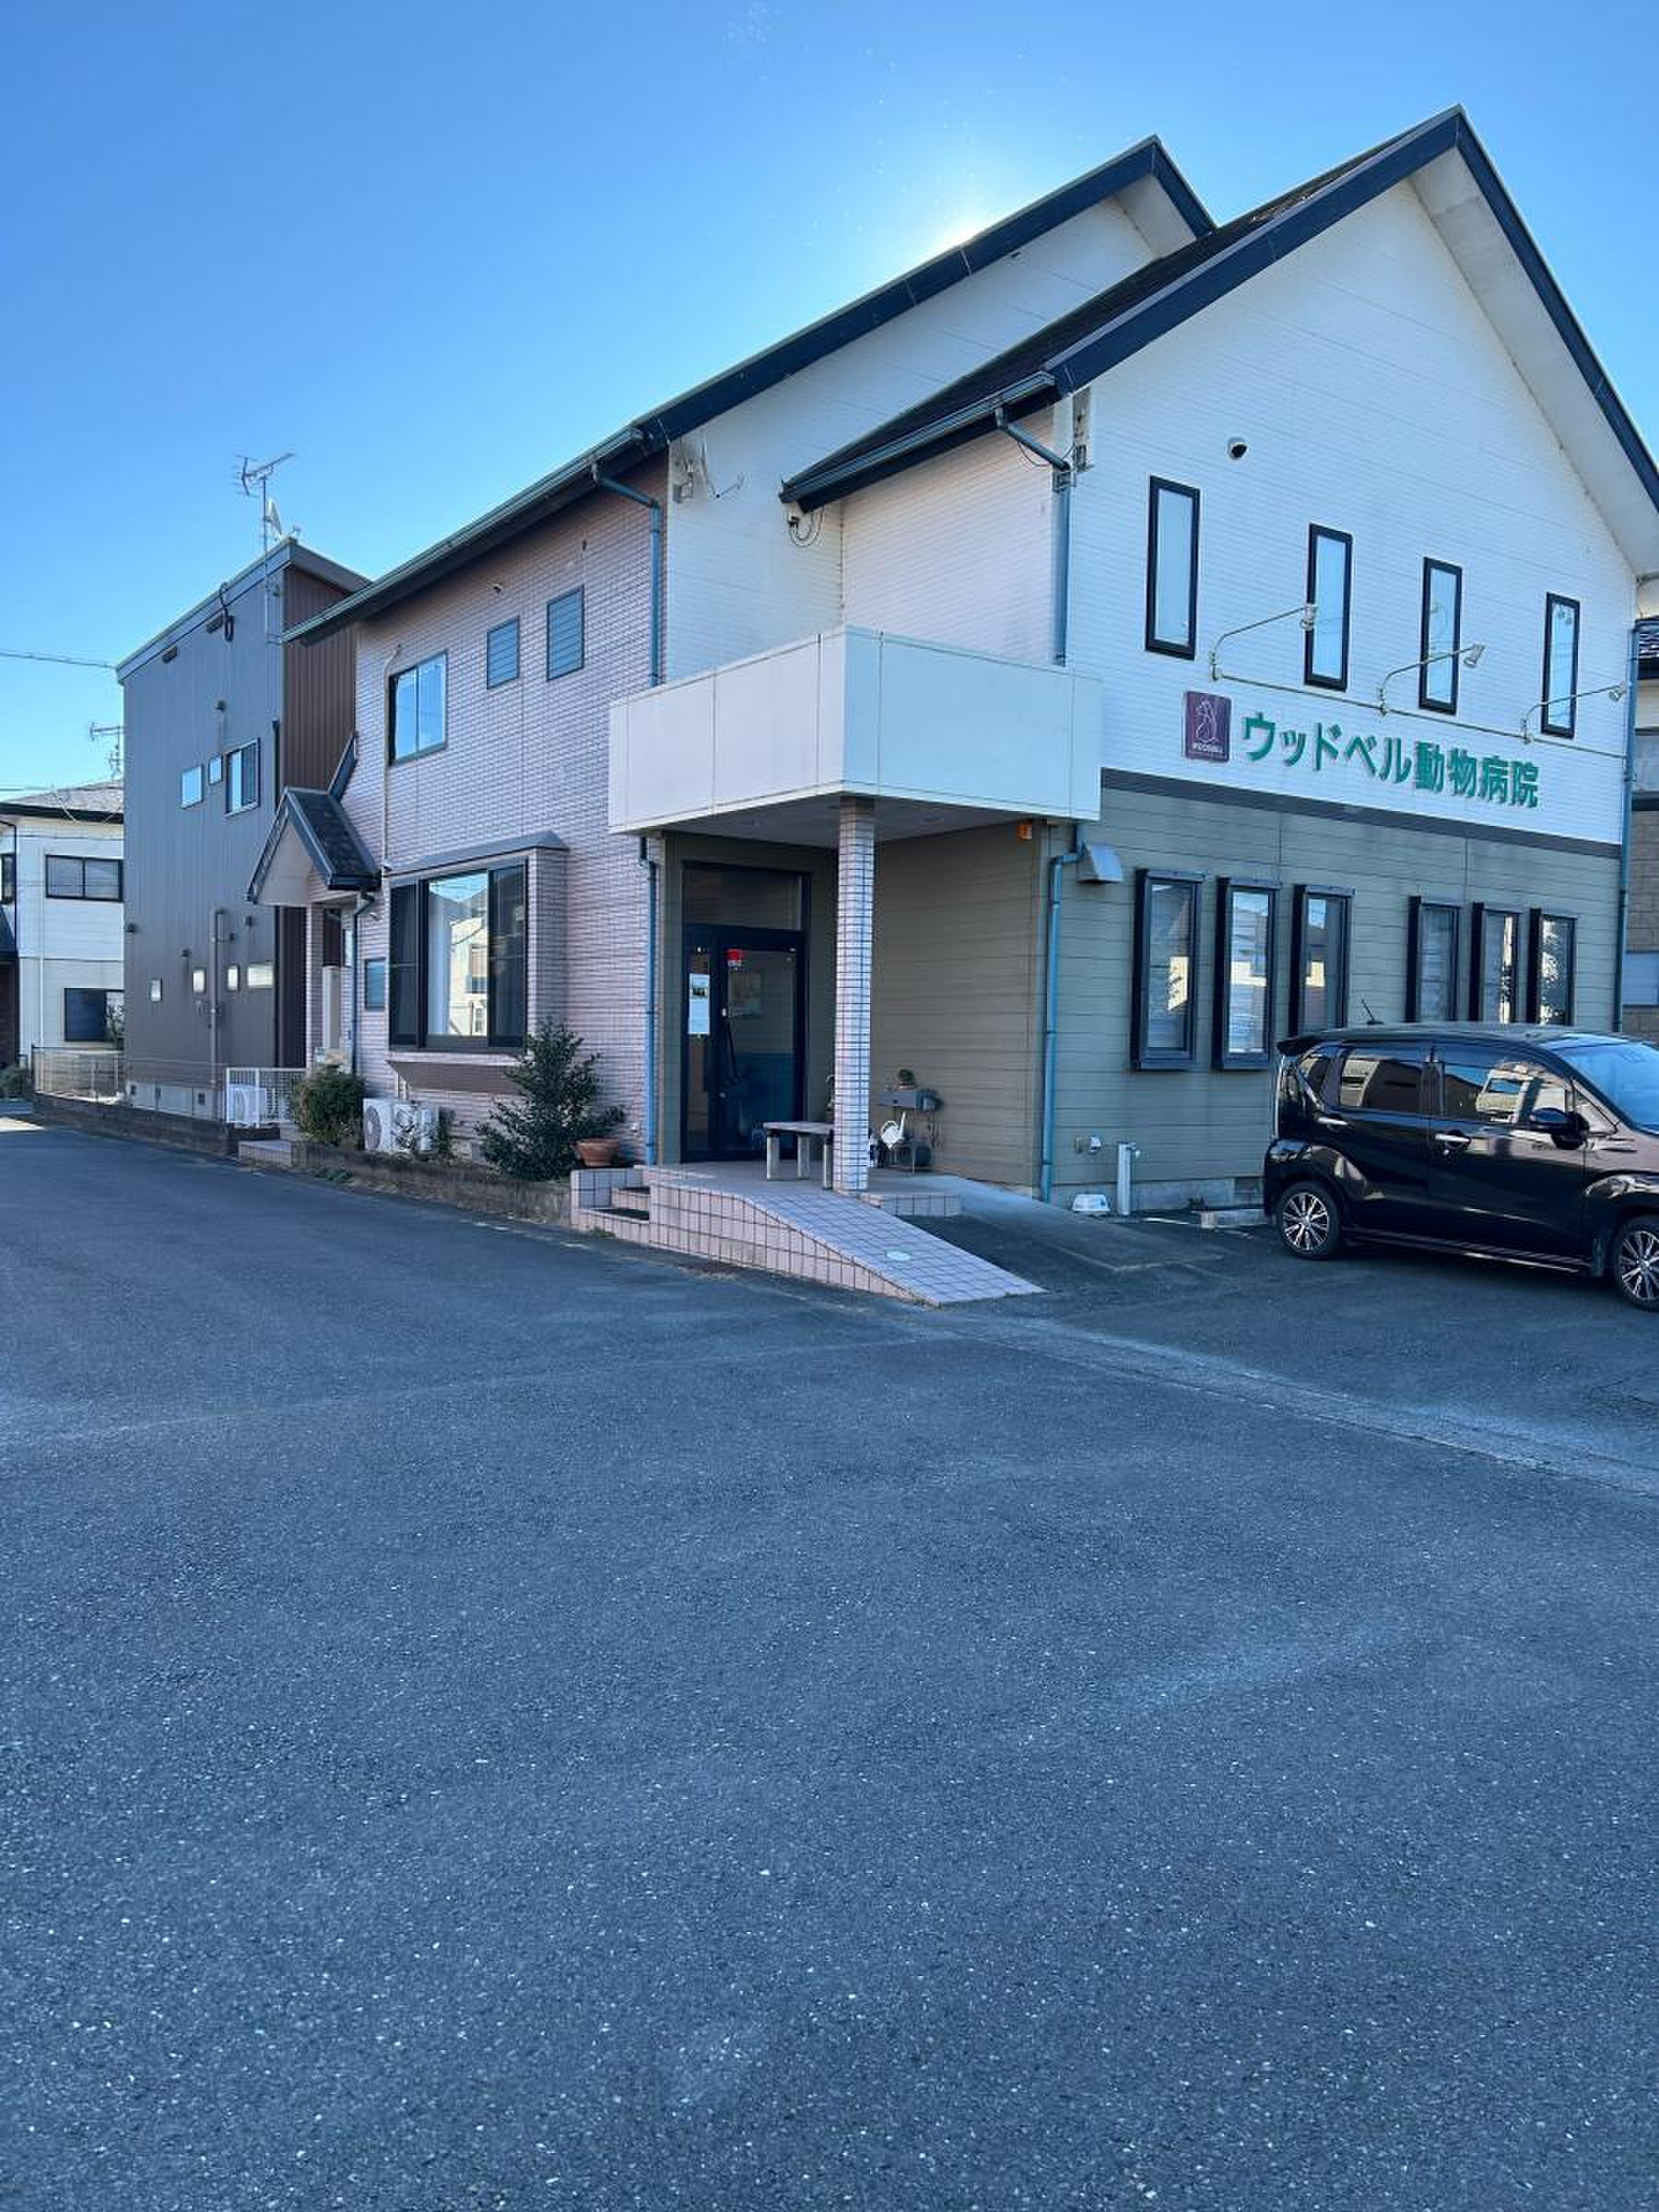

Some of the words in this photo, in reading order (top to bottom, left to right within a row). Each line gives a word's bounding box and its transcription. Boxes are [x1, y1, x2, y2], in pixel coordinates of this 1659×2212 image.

[1242, 712, 1539, 808] ウッドベル動物病院
